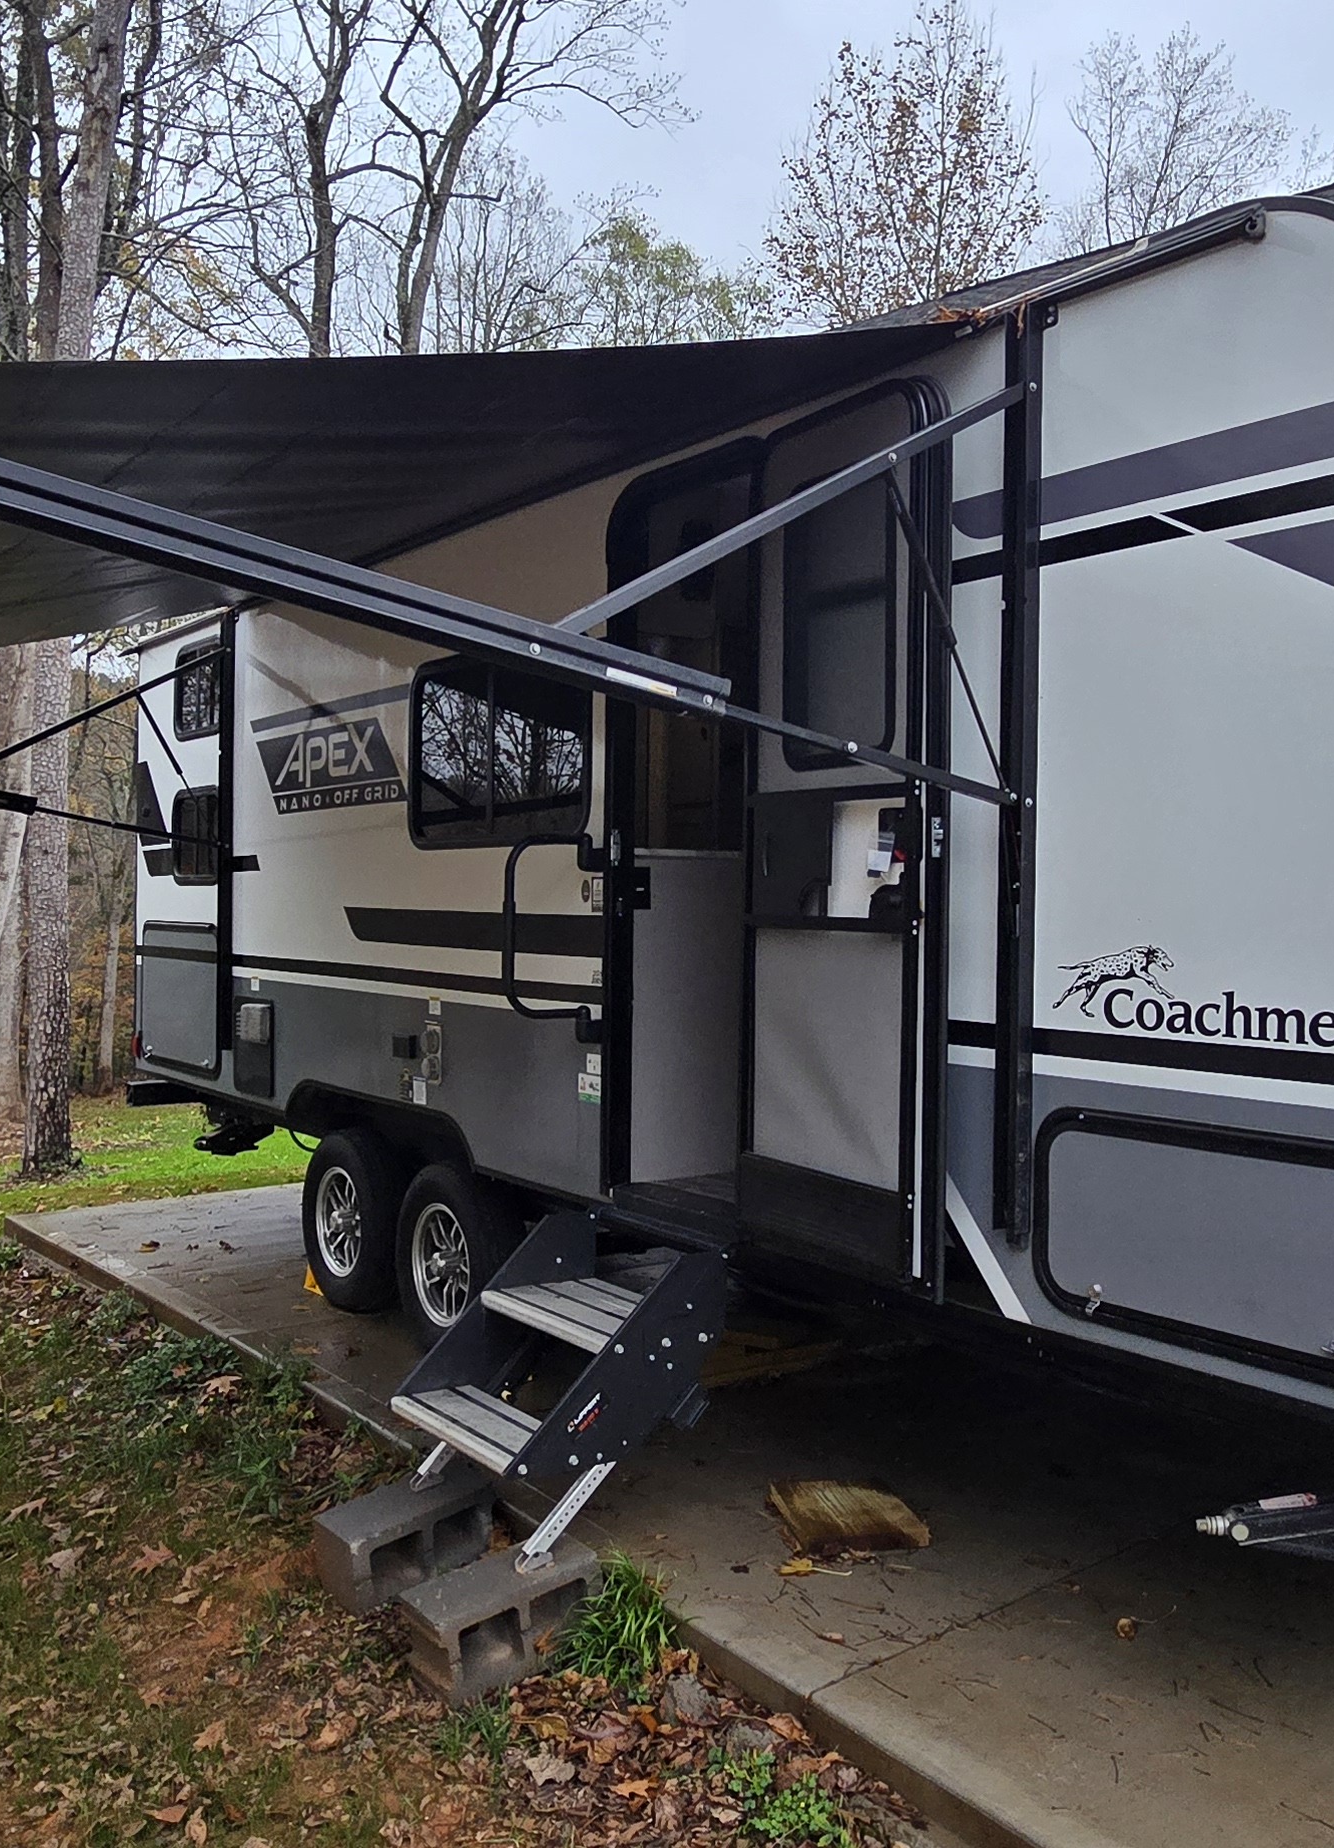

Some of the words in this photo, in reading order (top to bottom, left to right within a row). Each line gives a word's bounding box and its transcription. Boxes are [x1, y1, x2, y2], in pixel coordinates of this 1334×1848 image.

[275, 723, 375, 788] APEX
[279, 794, 322, 811] NANO
[333, 789, 359, 804] OFF
[364, 785, 399, 801] GRID
